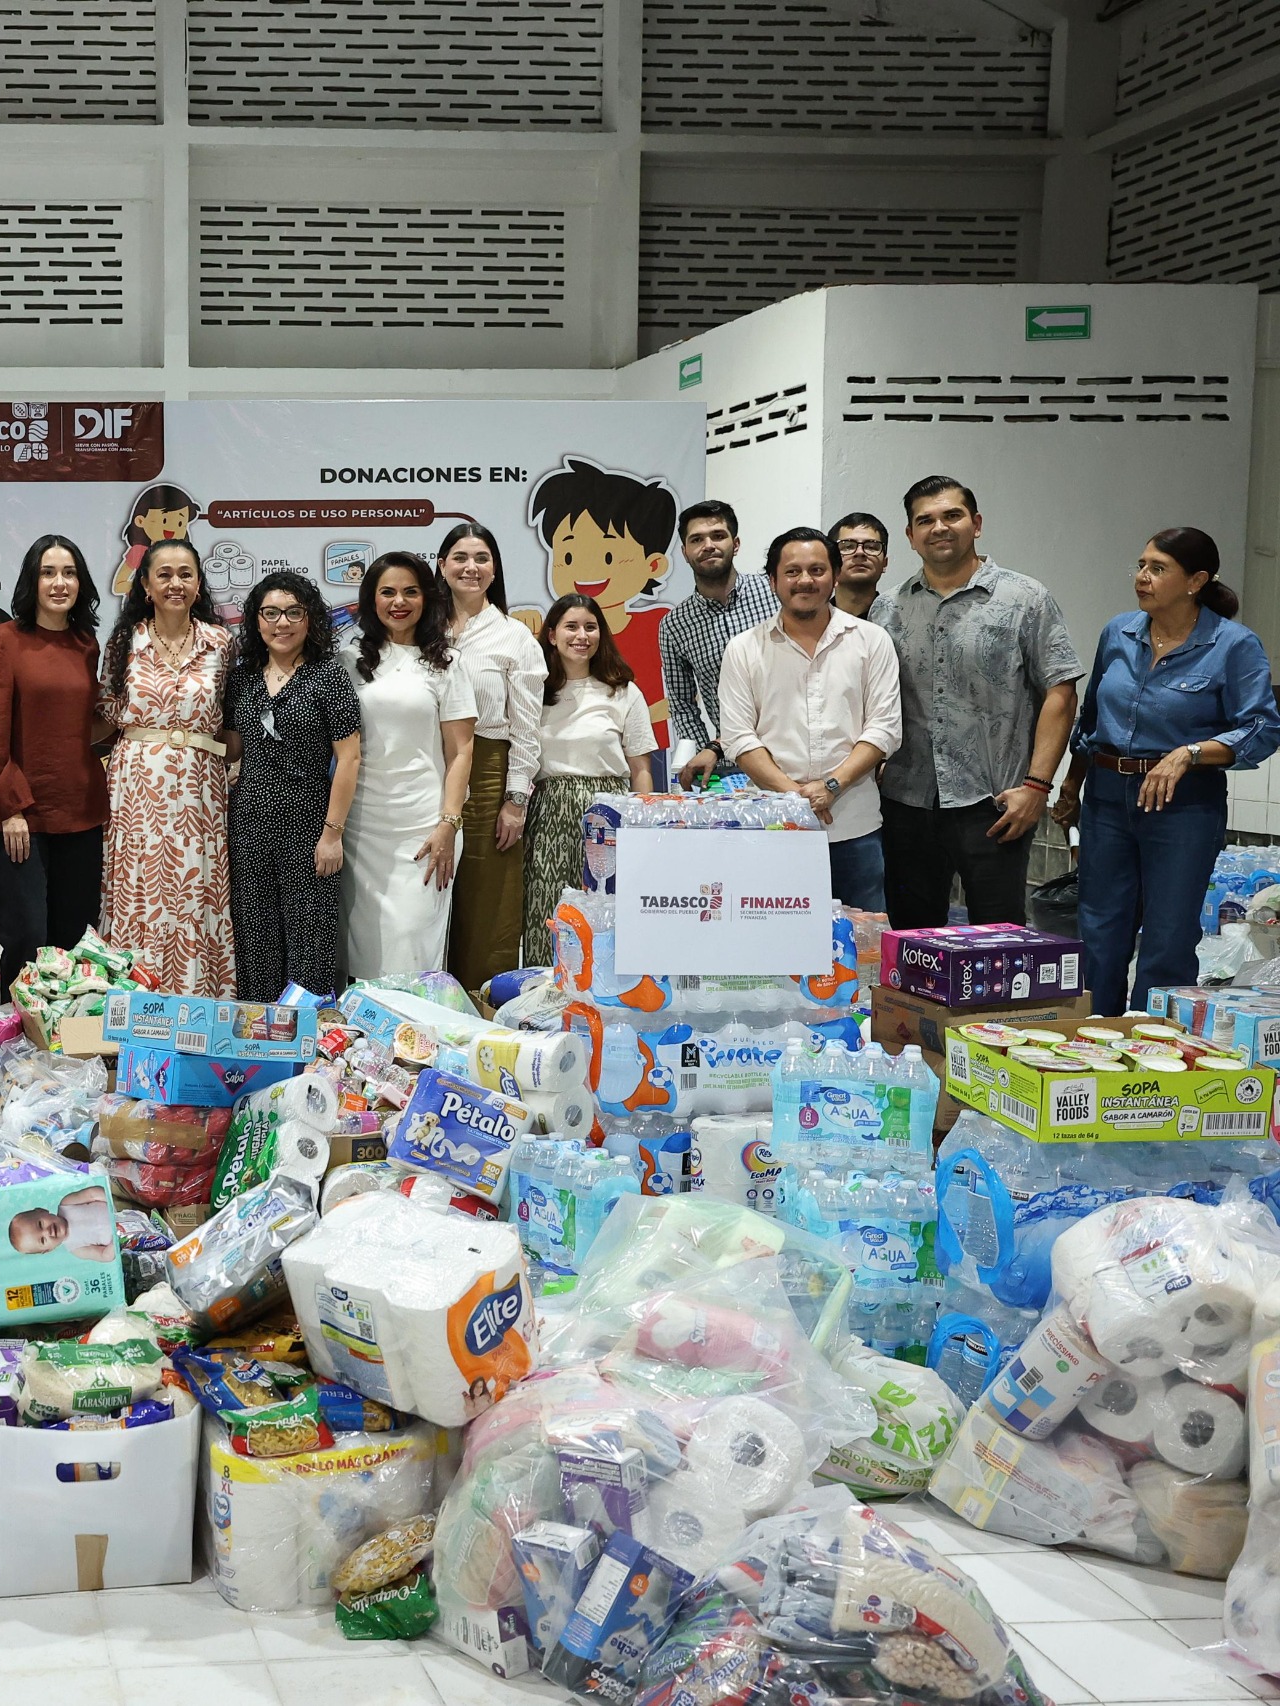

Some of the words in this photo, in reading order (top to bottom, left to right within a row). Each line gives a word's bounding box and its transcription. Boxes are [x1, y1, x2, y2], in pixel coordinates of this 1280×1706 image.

[74, 408, 132, 439] DIF
[320, 467, 482, 485] DONACIONES
[489, 466, 528, 484] EN:
[297, 509, 317, 519] DE
[321, 508, 347, 519] USO
[261, 559, 291, 567] PAPEL
[331, 553, 360, 566] PAÑALES
[261, 565, 309, 575] HIGIÉNICO
[640, 896, 709, 909] TABASCO
[740, 897, 810, 909] FINANZAS
[902, 942, 942, 972] kotex
[959, 961, 973, 1001] kotex
[110, 1006, 126, 1017] VALLEY
[143, 1002, 165, 1014] SOPA
[244, 1043, 260, 1051] SOPA
[950, 1053, 966, 1068] VALLEY
[975, 1052, 990, 1064] SOPA
[224, 1071, 247, 1084] Saba
[951, 1063, 967, 1080] FOODS
[1121, 1080, 1161, 1097] SOPA
[826, 1091, 847, 1100] Great
[1056, 1093, 1090, 1108] VALLEY
[1101, 1095, 1180, 1108] INSTANTÁNEA
[440, 1091, 517, 1143] Pétalo
[805, 1112, 812, 1121] 8
[830, 1106, 870, 1120] AGUA
[1056, 1106, 1089, 1122] FOODS
[1104, 1113, 1129, 1122] SABOR
[1137, 1109, 1173, 1119] CAMARÓN
[223, 1120, 253, 1191] Pétalo
[356, 1146, 387, 1160] 300
[485, 1163, 501, 1175] 400
[522, 1206, 528, 1216] 8
[534, 1207, 557, 1224] AGUA
[865, 1230, 884, 1240] Great
[868, 1247, 906, 1263] AGUA
[90, 1278, 101, 1293] 36
[6, 1289, 19, 1302] 12
[472, 1294, 519, 1351] Elite
[1044, 1327, 1080, 1367] PRECÍSSIMO
[76, 1395, 129, 1411] TABASQUEÑA
[223, 1465, 231, 1478] 8
[296, 1459, 335, 1475] ROLLO
[336, 1455, 362, 1470] MÁS
[221, 1484, 234, 1496] XL
